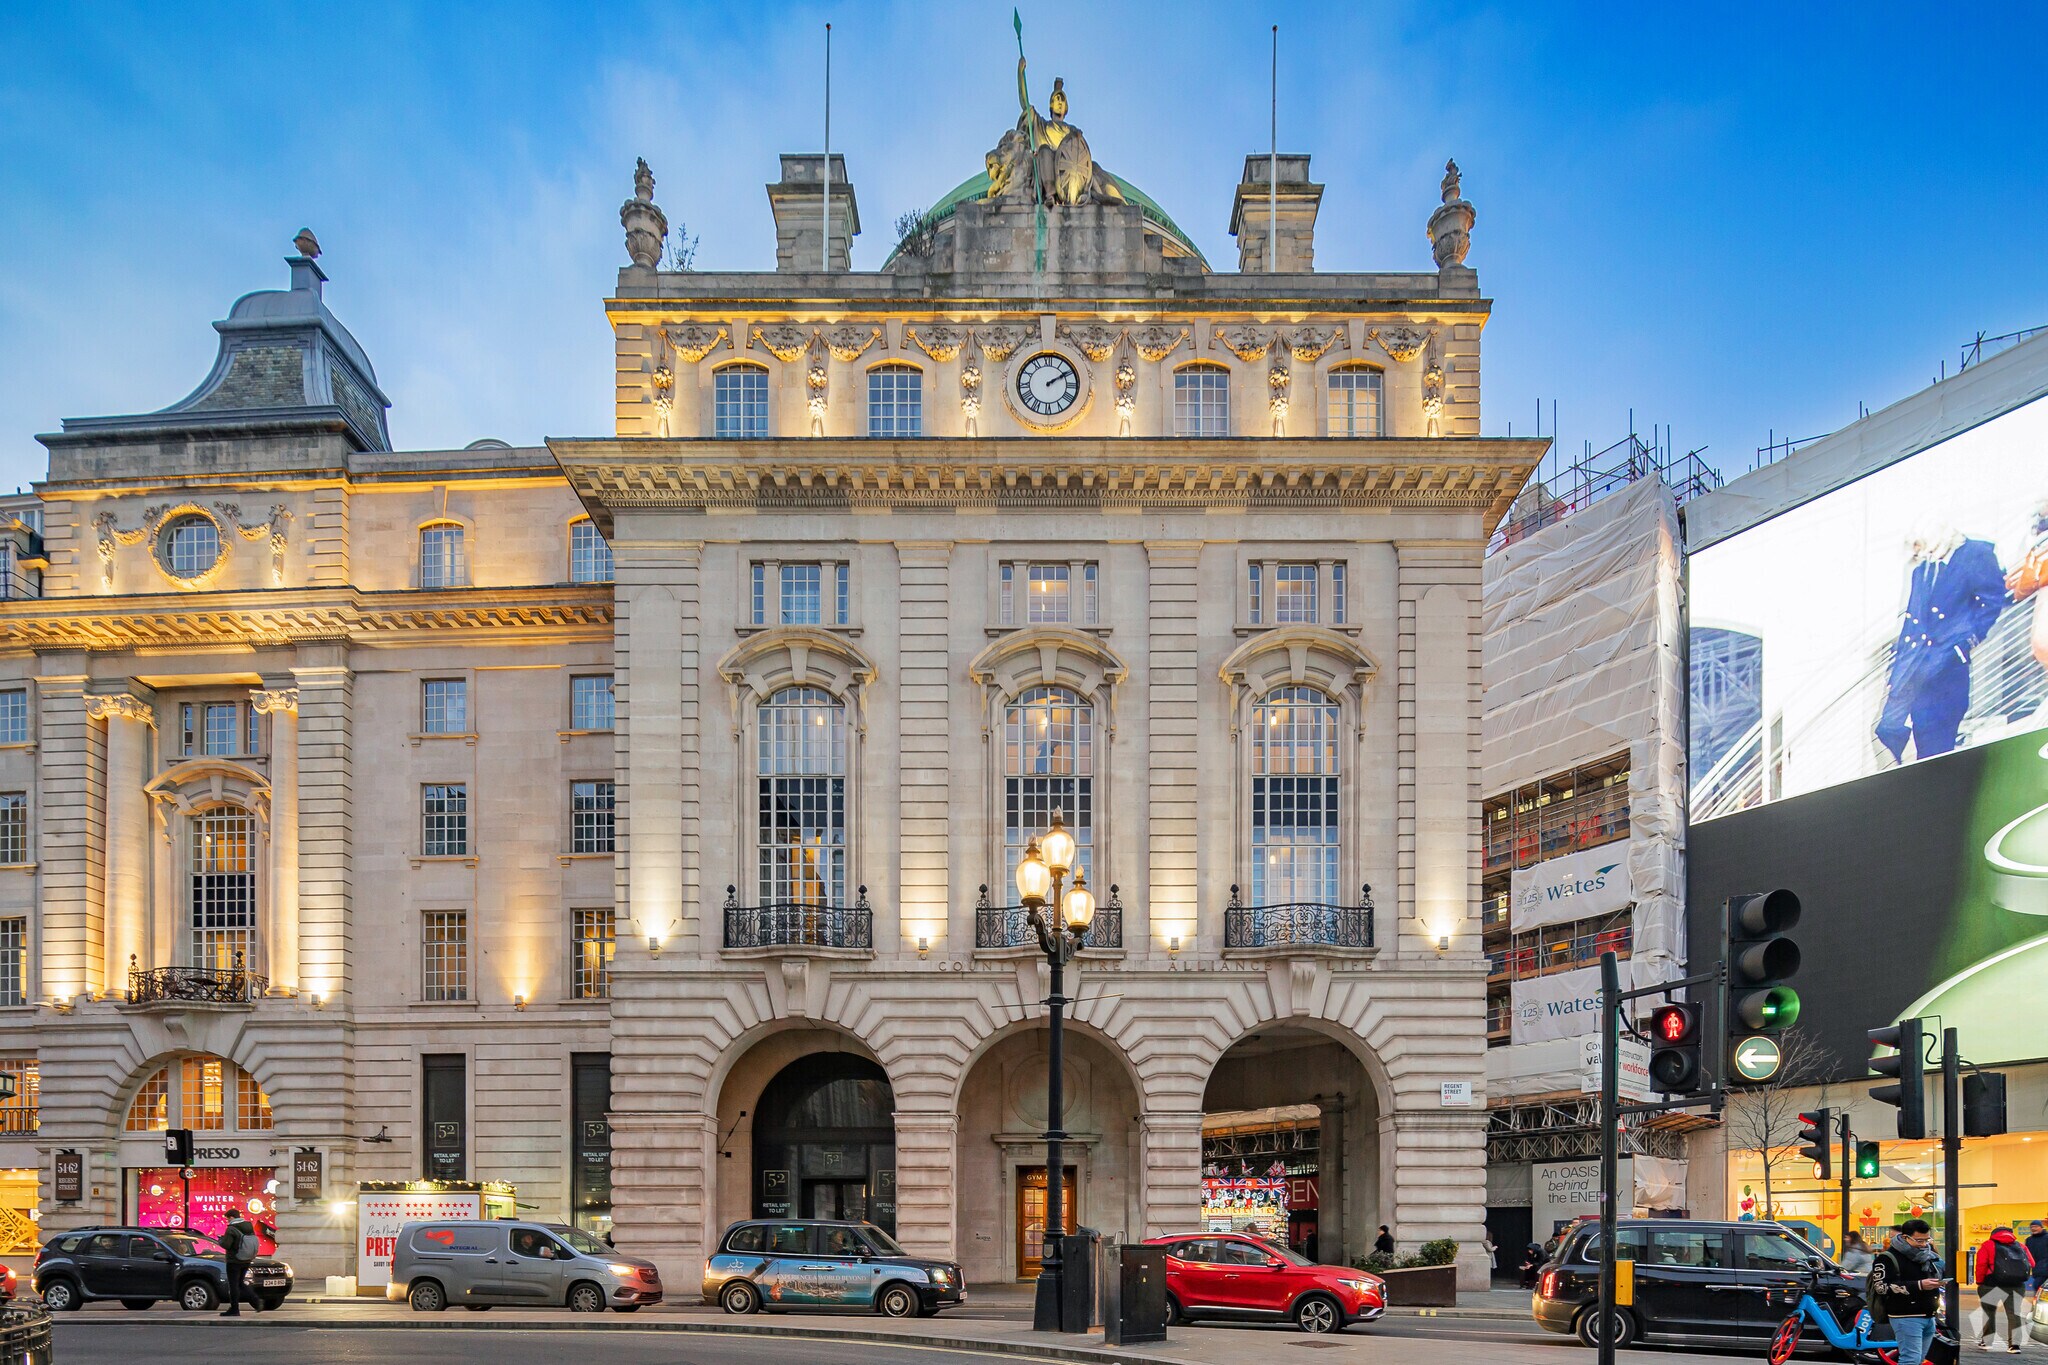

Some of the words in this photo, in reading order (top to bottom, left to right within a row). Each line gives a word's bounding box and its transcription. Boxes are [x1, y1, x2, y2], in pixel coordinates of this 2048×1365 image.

[1546, 876, 1606, 901] Wates
[1524, 893, 1538, 904] 125
[938, 961, 1021, 972] COUNTY
[1077, 960, 1121, 971] FIRE
[1168, 960, 1273, 971] ALLIANCE
[1326, 960, 1373, 971] LIFE
[1524, 1007, 1538, 1018] 125
[1547, 996, 1603, 1016] Wates
[1622, 1062, 1649, 1077] workforce
[438, 1125, 456, 1138] 52
[587, 1124, 604, 1138] 52
[193, 1147, 240, 1159] PRESSO
[826, 1154, 840, 1165] 52
[1541, 1168, 1557, 1179] An
[1560, 1166, 1600, 1178] OASIS
[768, 1173, 786, 1188] 52
[1548, 1179, 1590, 1192] behind
[1548, 1193, 1567, 1204] the
[366, 1224, 380, 1237] Big
[383, 1222, 400, 1236] Nigh
[366, 1237, 396, 1256] PRET
